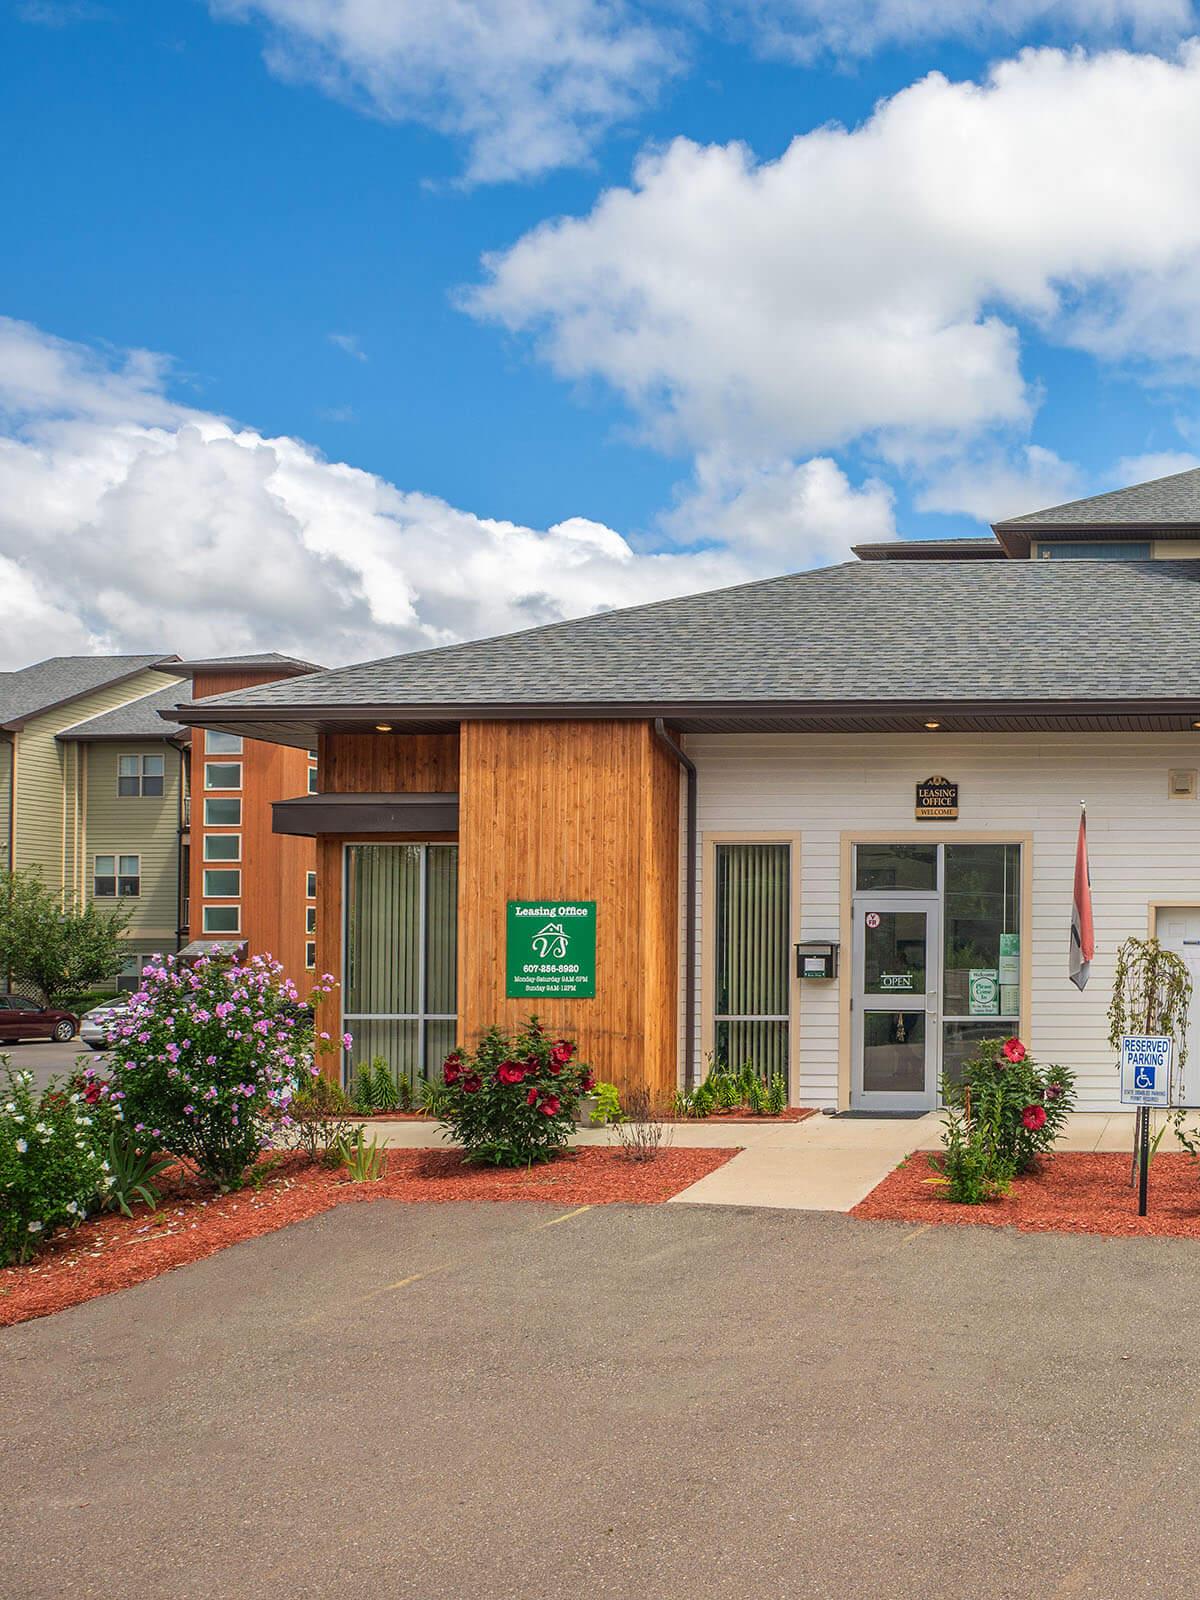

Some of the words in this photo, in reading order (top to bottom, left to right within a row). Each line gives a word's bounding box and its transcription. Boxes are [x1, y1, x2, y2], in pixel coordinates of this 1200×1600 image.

[919, 789, 956, 797] LEASING
[922, 798, 952, 806] OFFICE
[515, 907, 557, 918] Leasing
[558, 907, 588, 917] Office
[883, 977, 911, 986] OPEN
[1125, 1040, 1168, 1052] RESERVED
[1128, 1053, 1164, 1065] PARKING
